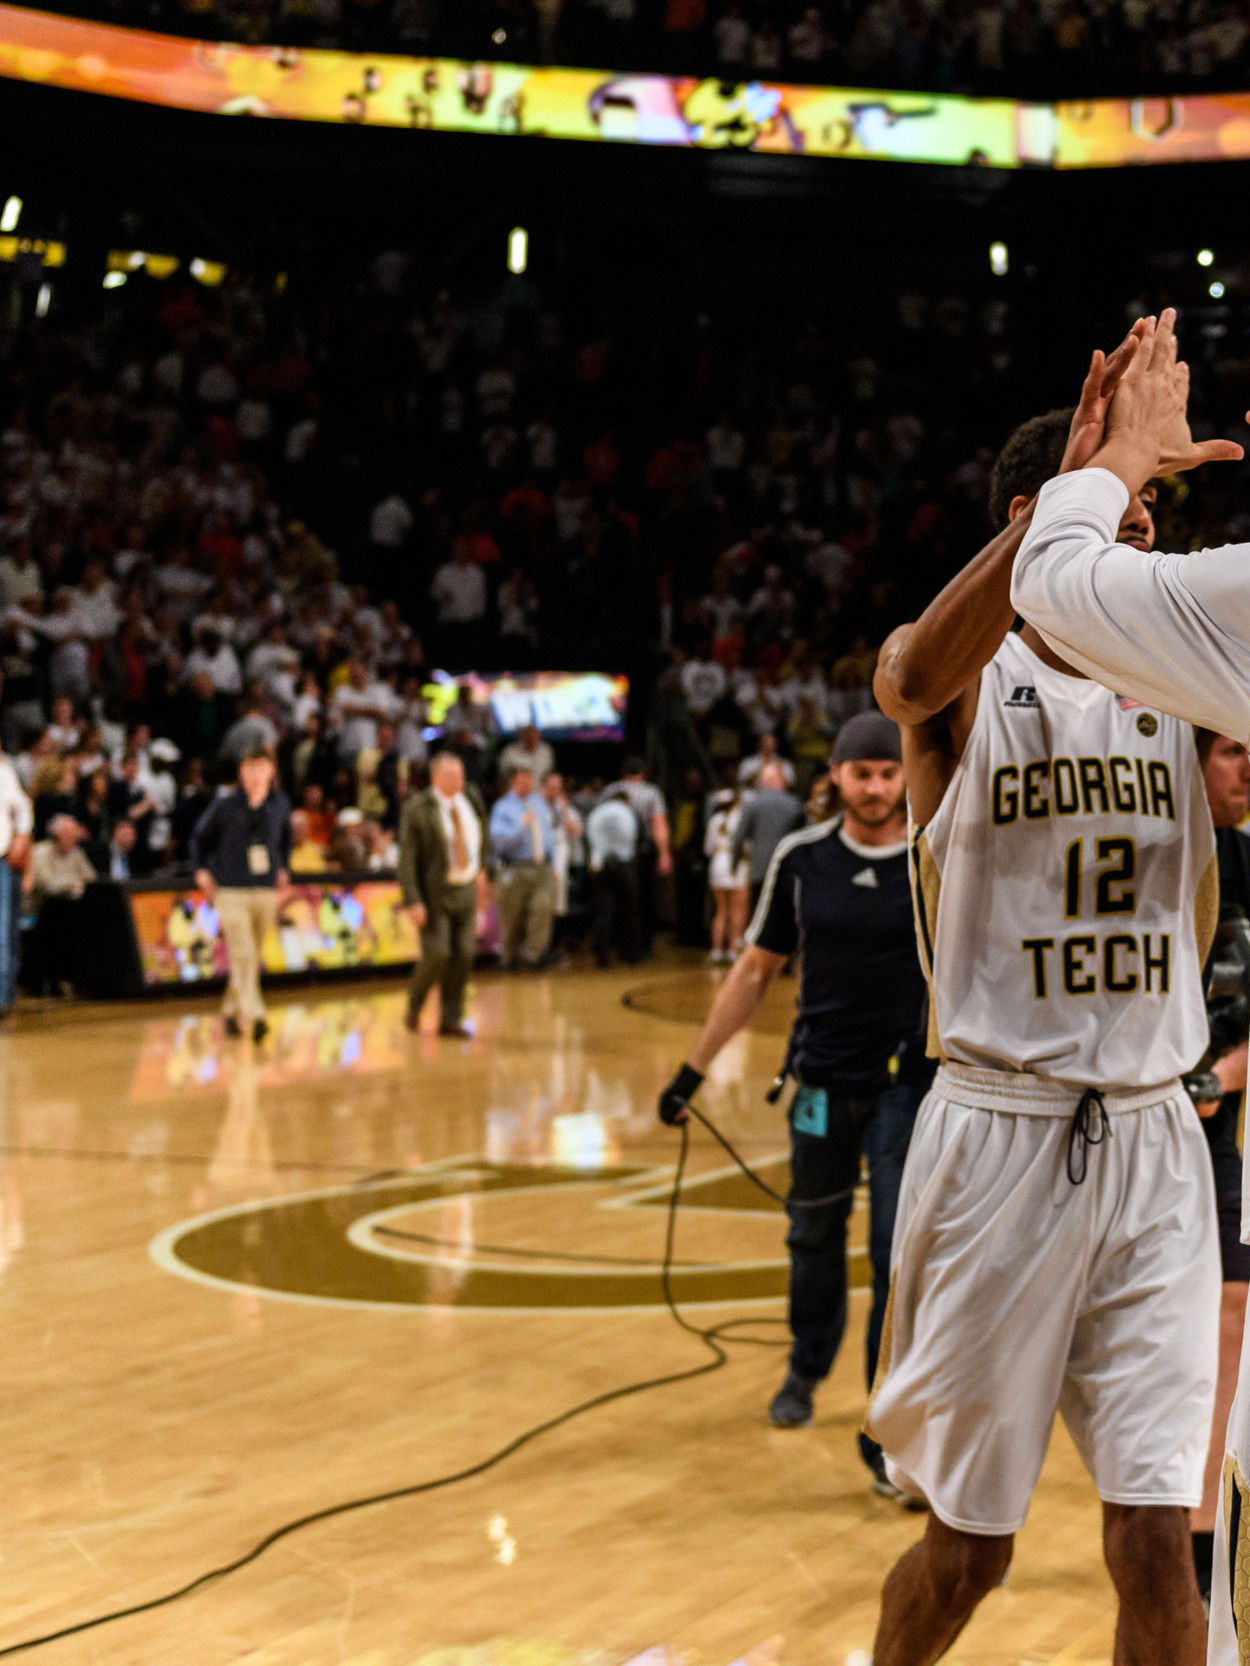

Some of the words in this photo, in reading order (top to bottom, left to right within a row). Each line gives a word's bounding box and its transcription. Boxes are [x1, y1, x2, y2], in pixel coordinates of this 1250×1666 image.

[992, 756, 1176, 826] GEORGIA
[1063, 835, 1137, 920] 12
[1021, 933, 1170, 1000] TECH
